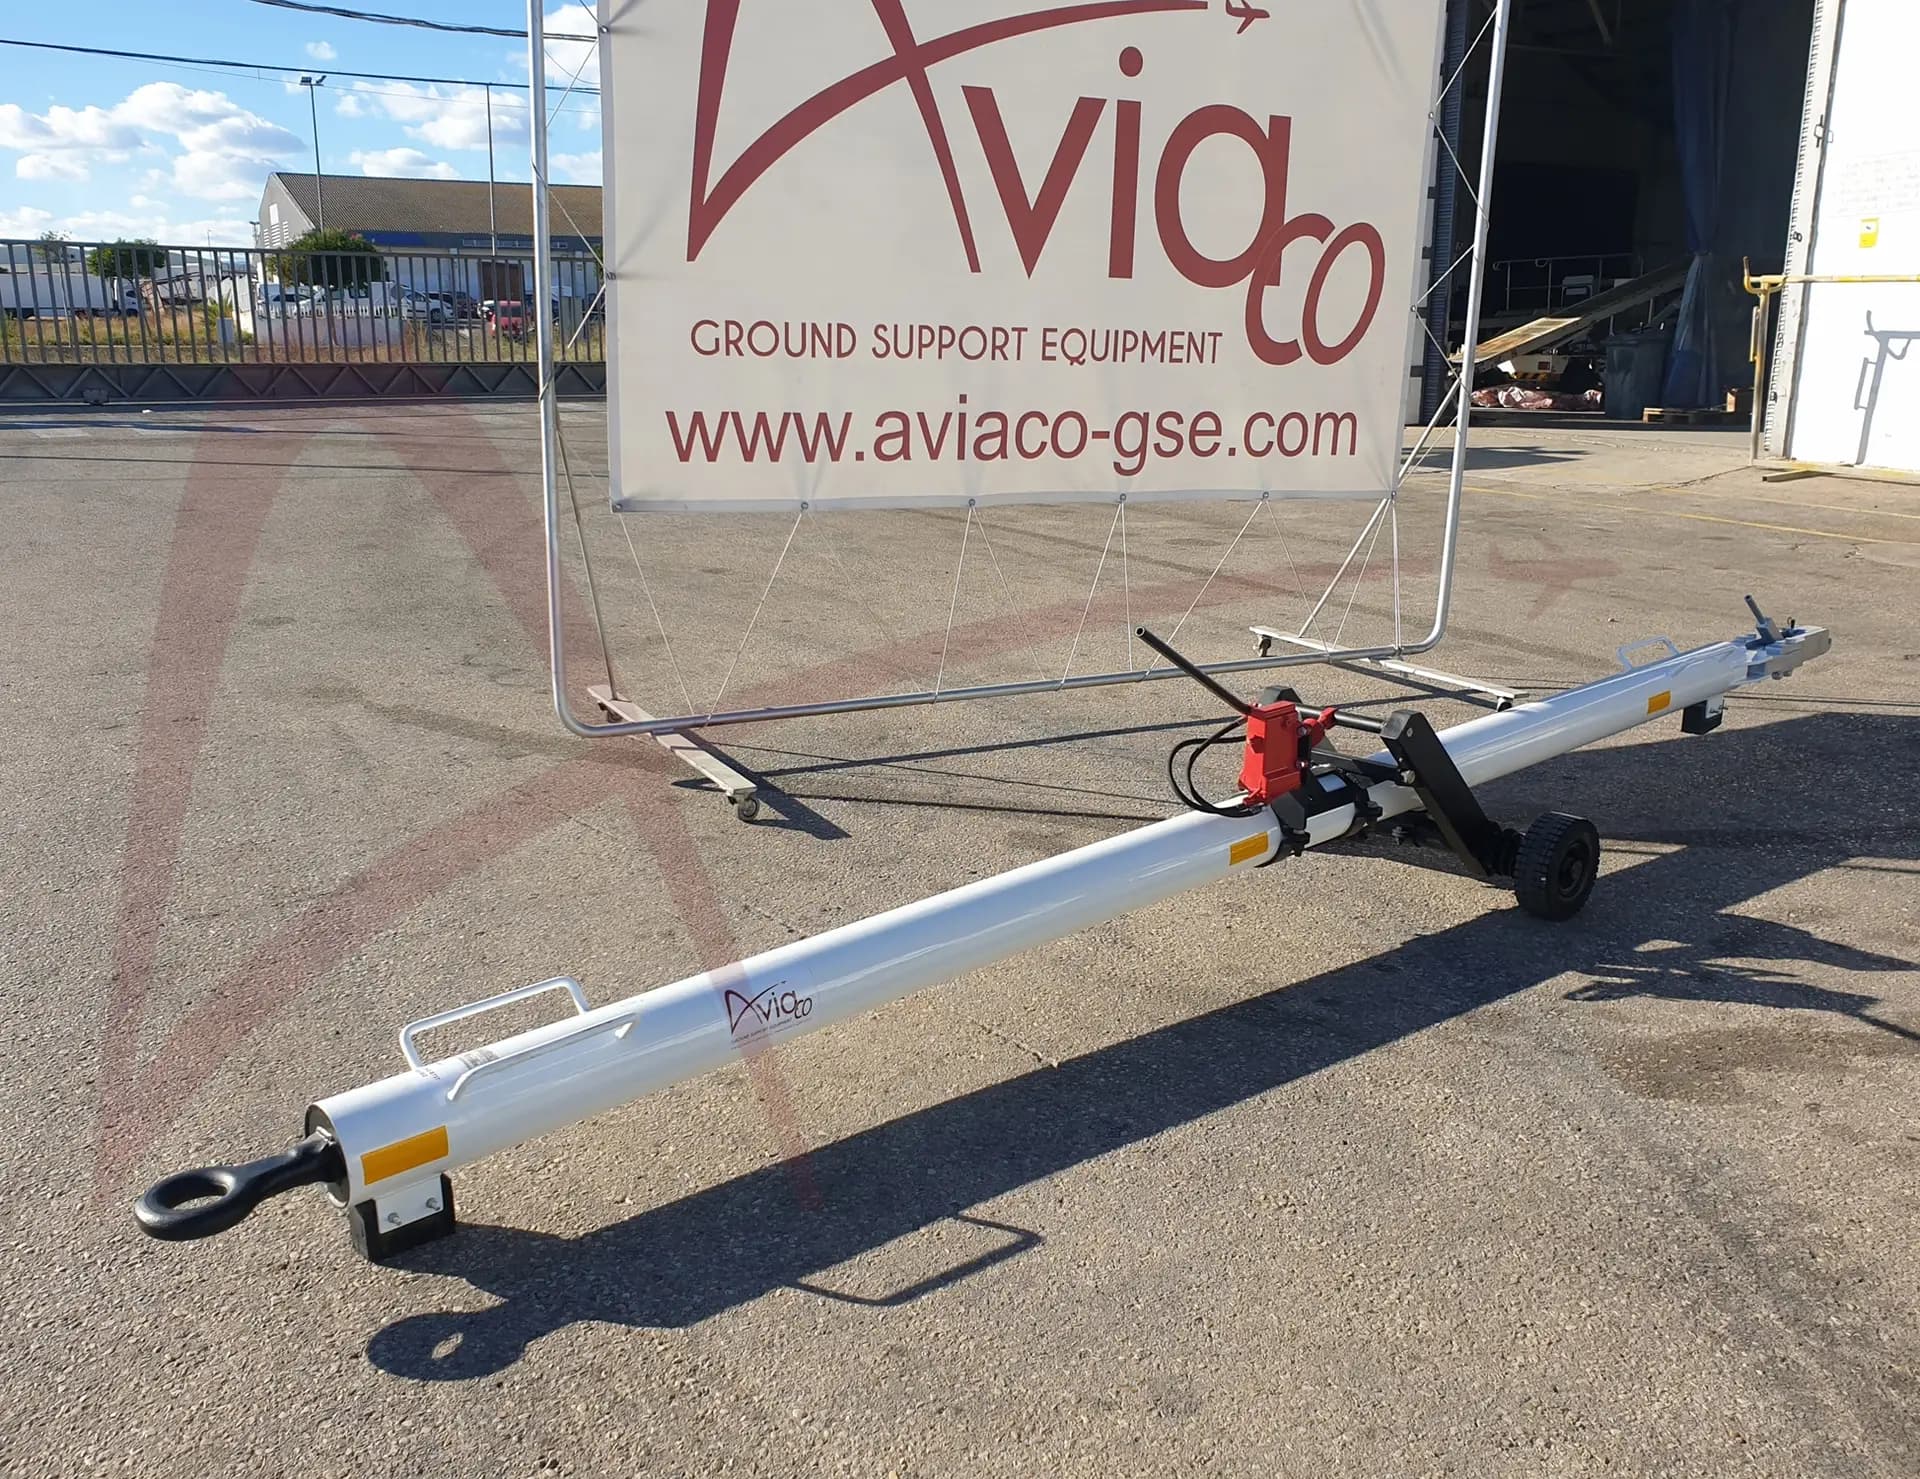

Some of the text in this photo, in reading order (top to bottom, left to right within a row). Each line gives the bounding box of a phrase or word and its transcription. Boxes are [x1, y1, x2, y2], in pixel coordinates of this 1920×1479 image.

[690, 319, 1223, 367] GROUND SUPPORT EQUIPMENT
[665, 394, 1359, 477] www.aviaco-gse.com
